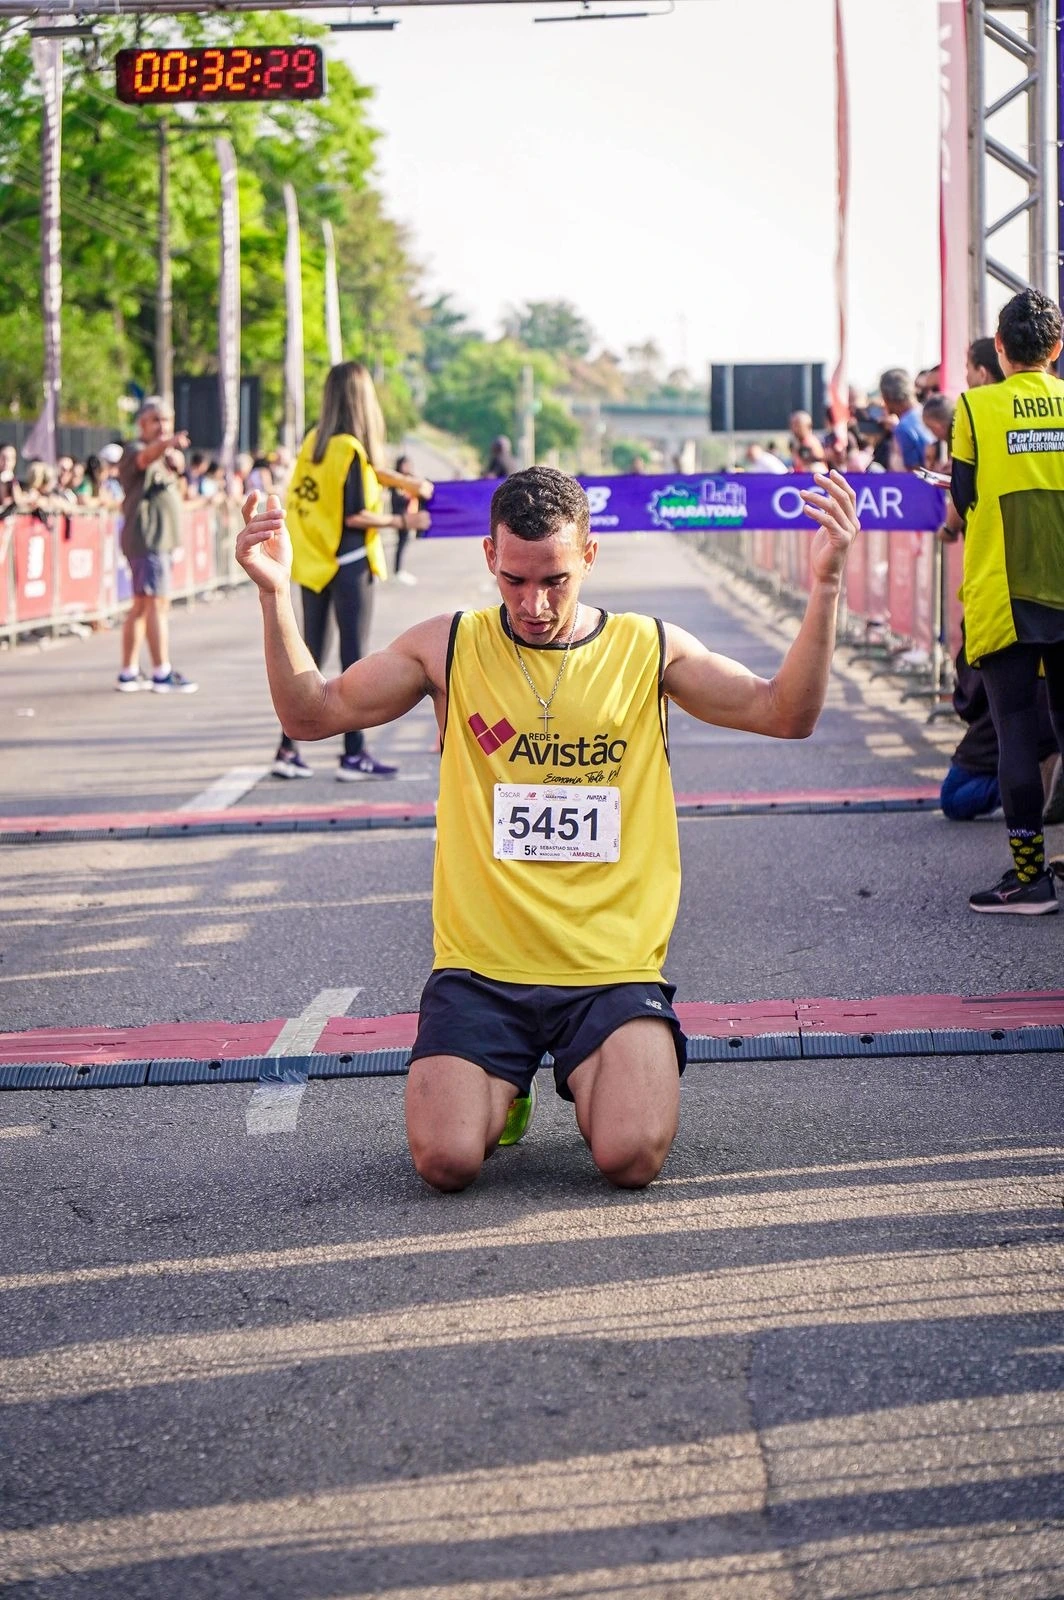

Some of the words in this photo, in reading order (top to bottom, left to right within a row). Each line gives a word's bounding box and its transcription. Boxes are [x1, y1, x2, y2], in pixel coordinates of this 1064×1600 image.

[133, 49, 317, 94] 00:32:29
[1013, 395, 1064, 419] ÁRBIT
[659, 504, 748, 518] MARATONA
[772, 485, 904, 519] OAR
[529, 732, 551, 741] REDE
[508, 733, 628, 767] Avistão
[543, 772, 583, 784] Economia
[508, 806, 598, 841] 5451
[524, 844, 537, 856] 5K
